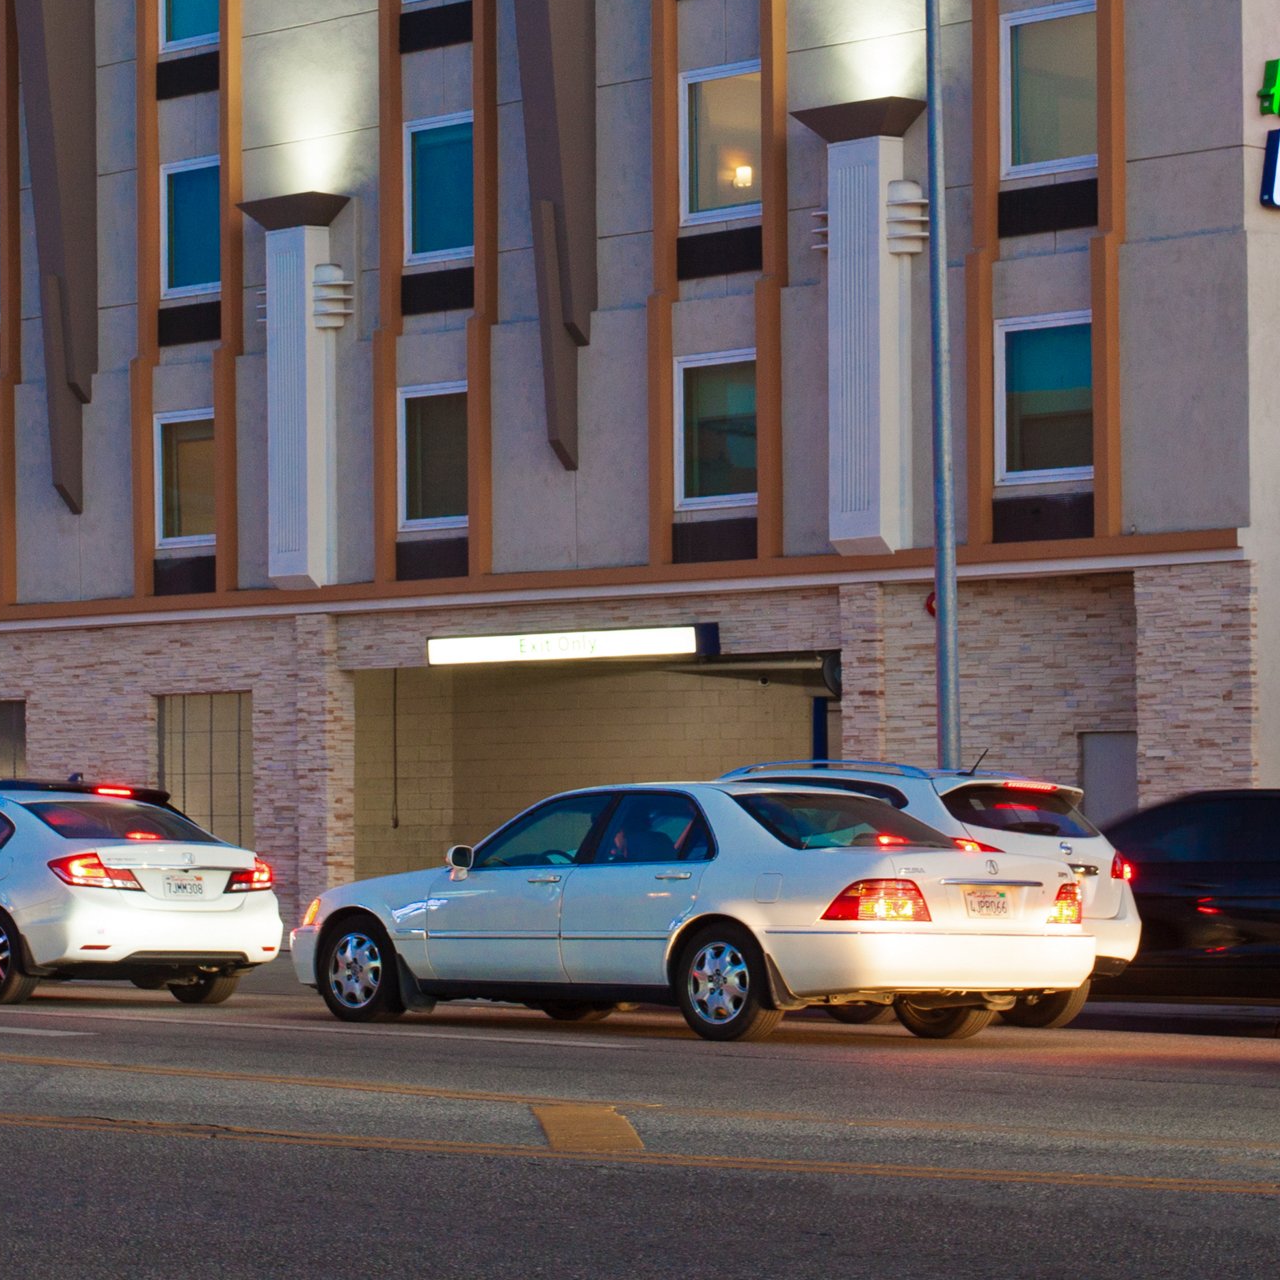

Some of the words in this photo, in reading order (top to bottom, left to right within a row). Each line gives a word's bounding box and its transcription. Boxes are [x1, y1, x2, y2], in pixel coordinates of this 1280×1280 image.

[519, 638, 551, 653] Exit
[558, 635, 597, 654] Only
[166, 882, 204, 895] 7JMM308
